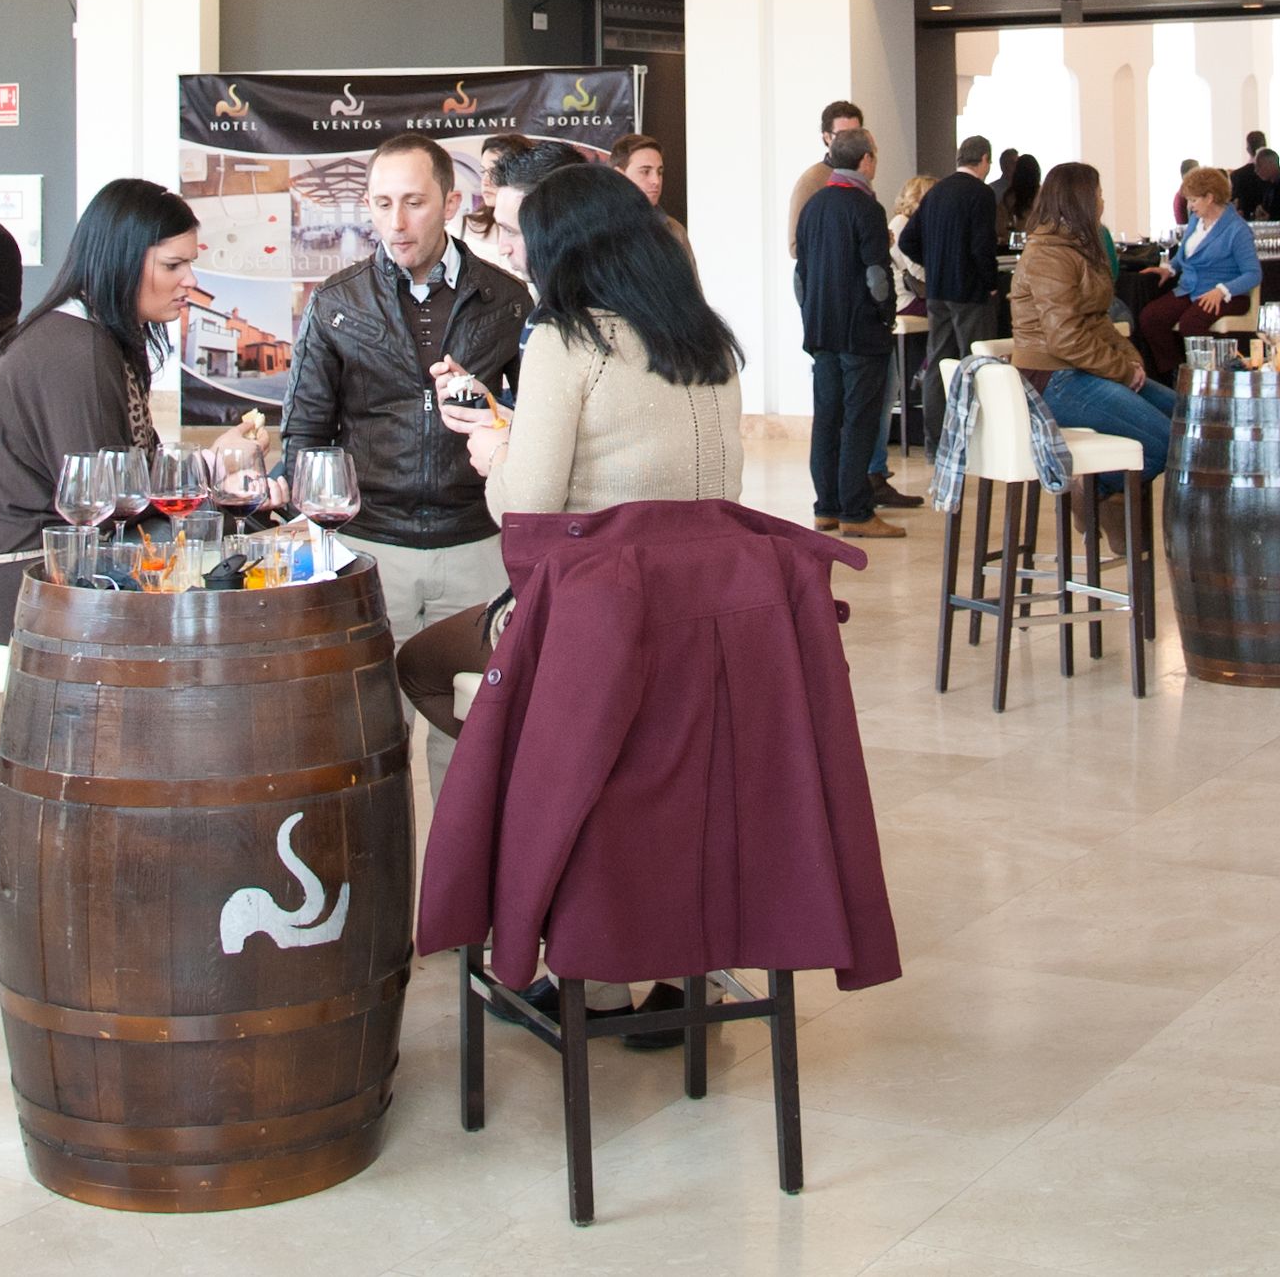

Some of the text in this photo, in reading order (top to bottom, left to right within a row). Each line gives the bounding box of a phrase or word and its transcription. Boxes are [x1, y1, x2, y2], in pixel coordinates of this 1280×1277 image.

[210, 121, 258, 131] HOTEL
[312, 119, 382, 131] EVENTOS
[406, 117, 517, 129] RESTAURANTE
[547, 115, 612, 126] BODEGA
[212, 248, 311, 271] Cosecha
